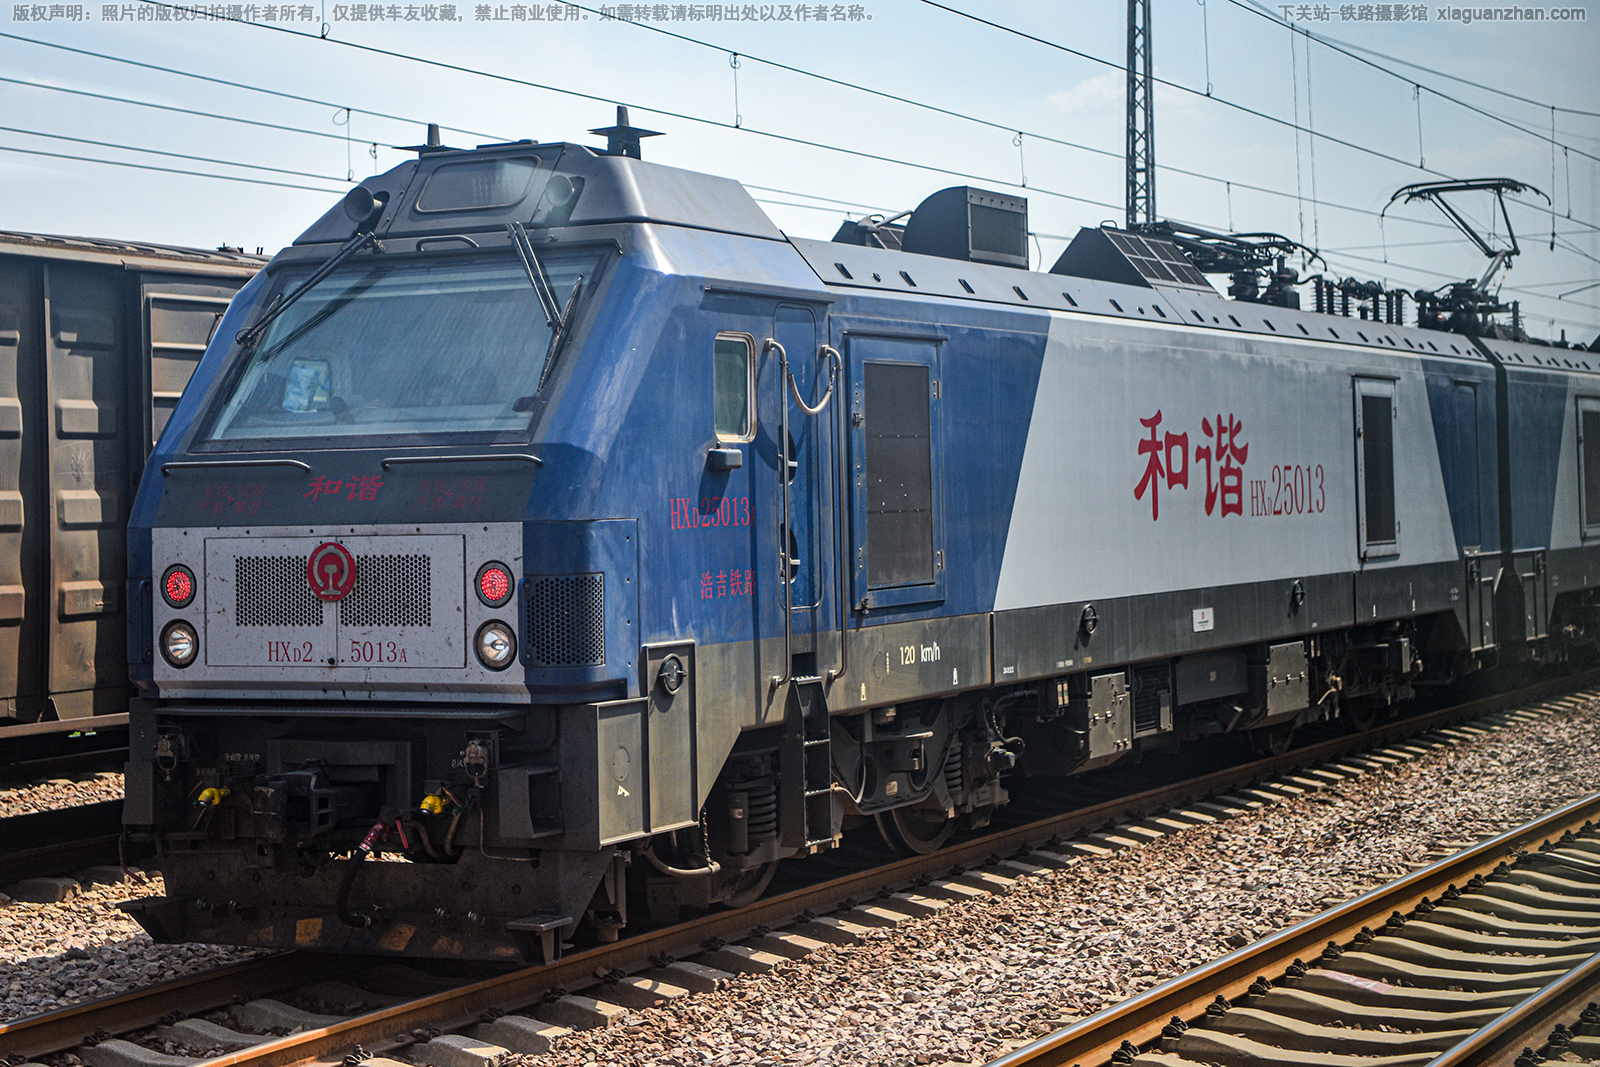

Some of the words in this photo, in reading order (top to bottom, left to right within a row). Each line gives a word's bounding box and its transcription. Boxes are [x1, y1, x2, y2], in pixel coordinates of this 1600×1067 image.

[1134, 409, 1249, 521] 和谐
[303, 474, 384, 503] 和谐
[700, 567, 756, 600] 浩吉铁路
[350, 640, 408, 663] 5013A
[899, 645, 916, 666] 120
[920, 641, 941, 663] km/h
